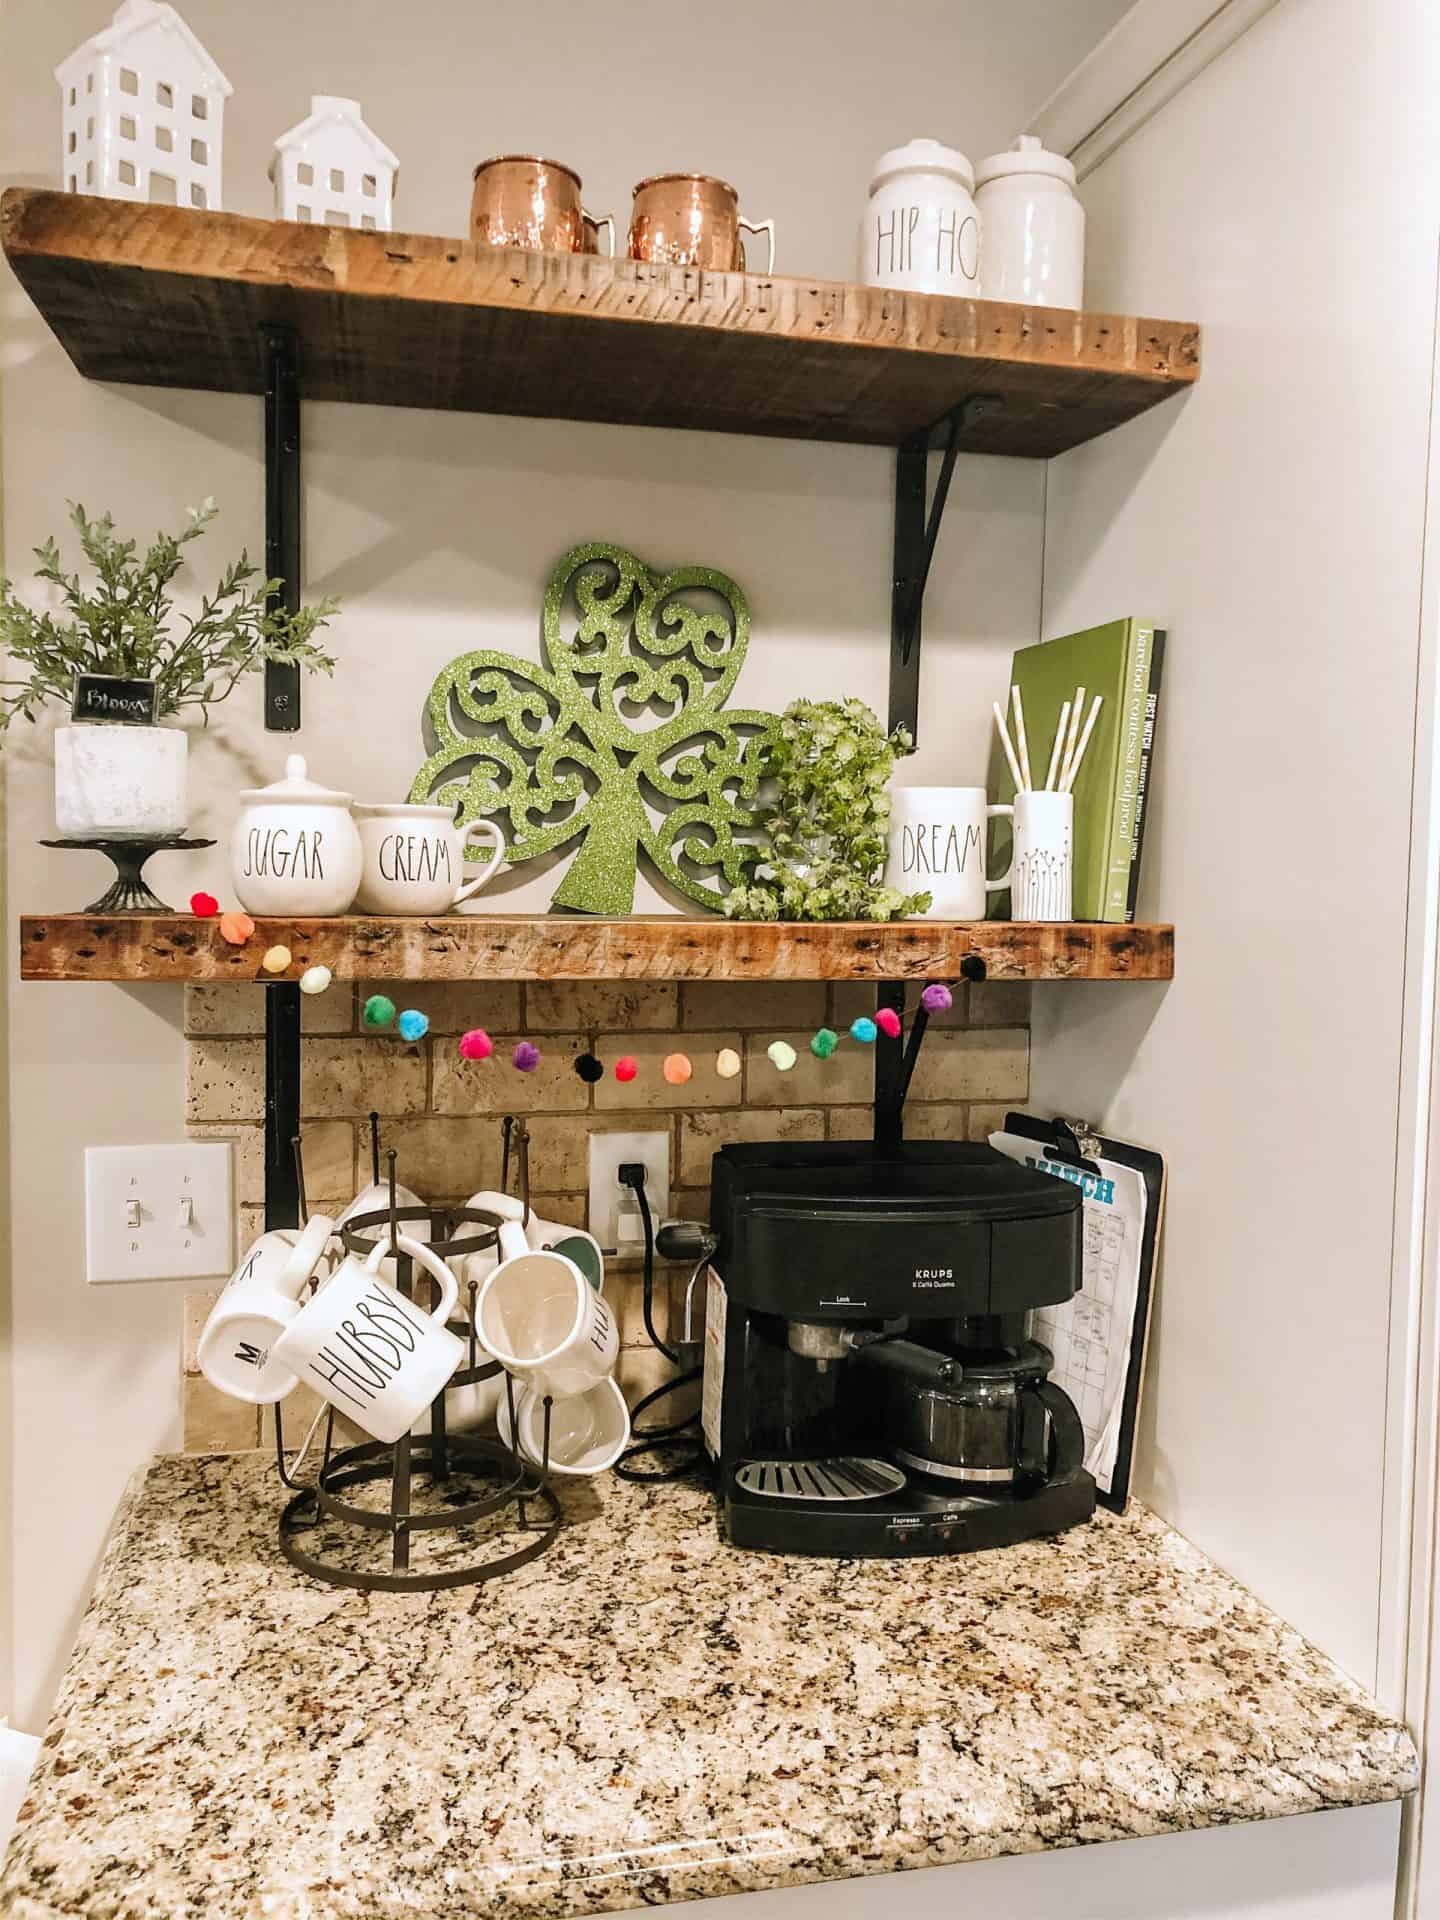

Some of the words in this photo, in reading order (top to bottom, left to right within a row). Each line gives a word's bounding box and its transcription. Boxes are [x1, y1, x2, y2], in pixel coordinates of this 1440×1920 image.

[876, 206, 920, 277] HIP
[1133, 628, 1153, 694] barefoot
[1126, 697, 1142, 765] contessa
[1144, 693, 1157, 719] FIRST
[1141, 720, 1153, 750] WATCH
[1119, 768, 1138, 841] foolproof
[243, 827, 323, 880] SUGAR
[379, 834, 451, 884] CREAM
[902, 823, 983, 874] DREAM
[915, 1269, 953, 1279] KRUPS
[309, 1283, 425, 1409] HUBBY
